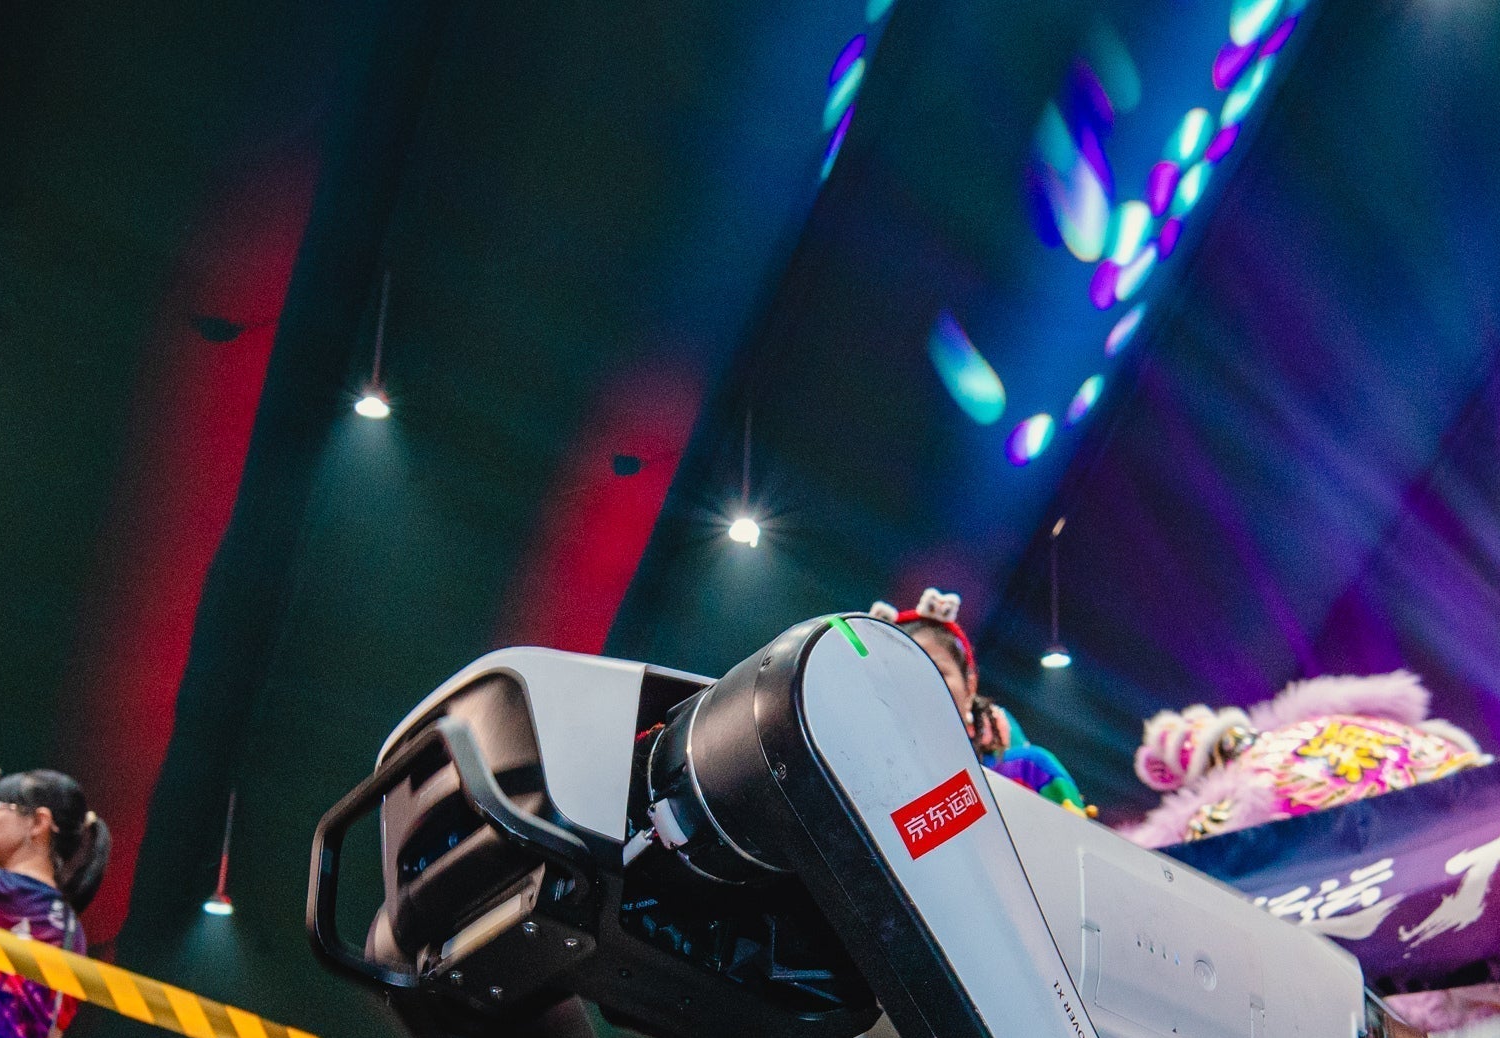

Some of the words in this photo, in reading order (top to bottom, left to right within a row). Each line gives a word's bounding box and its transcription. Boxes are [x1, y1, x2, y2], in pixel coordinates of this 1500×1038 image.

[903, 783, 979, 843] 京东运动
[1053, 980, 1065, 1000] X1
